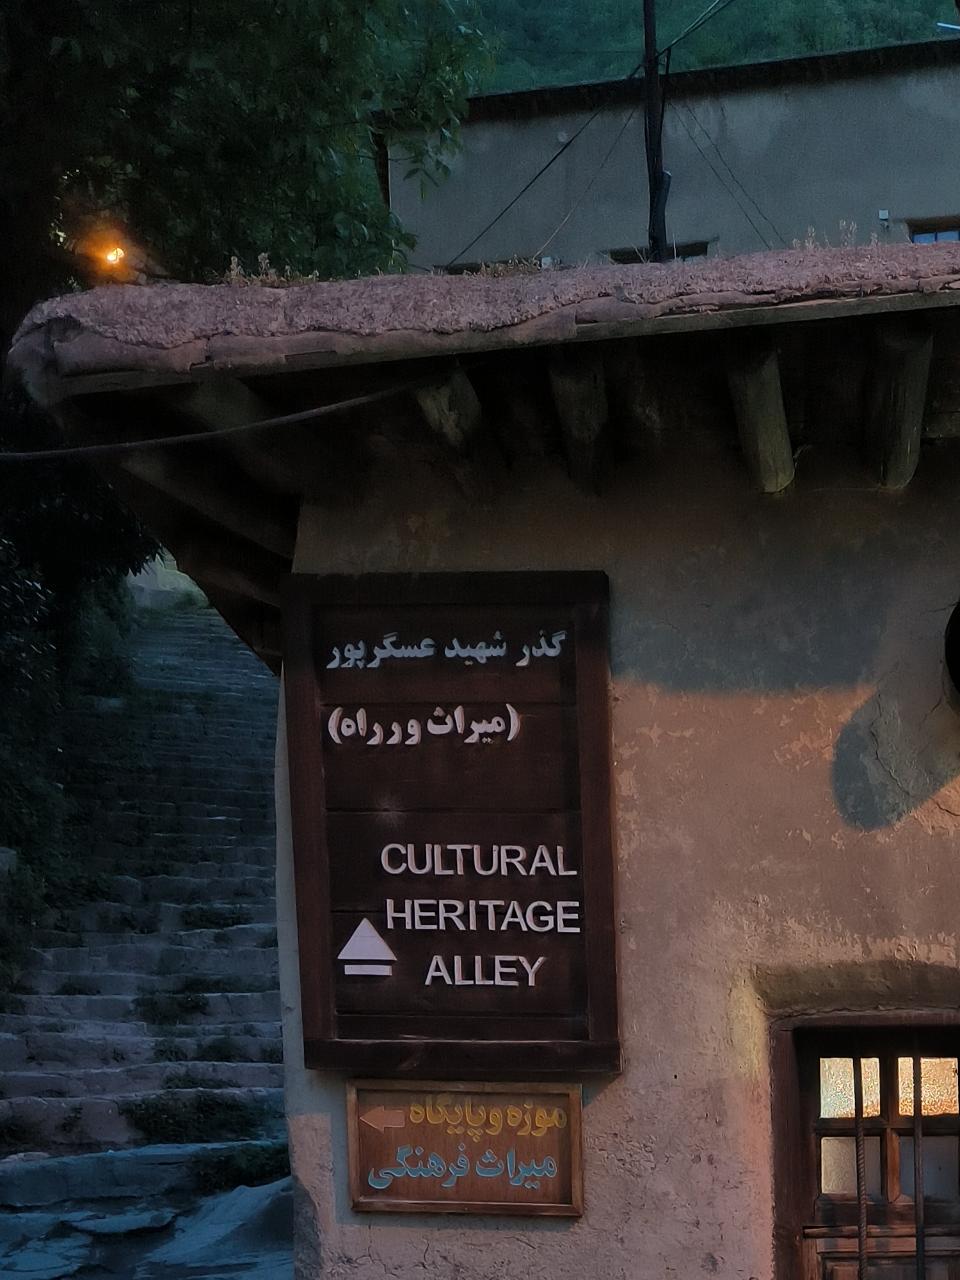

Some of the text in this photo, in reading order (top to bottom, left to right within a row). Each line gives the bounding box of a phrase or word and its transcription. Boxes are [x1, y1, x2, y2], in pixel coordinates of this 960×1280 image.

[444, 630, 507, 664] شهید
[515, 630, 566, 667] گذر
[380, 843, 578, 876] CULTURAL
[386, 899, 581, 933] HERITAGE
[424, 955, 546, 986] ALLEY
[409, 1094, 484, 1142] پایگاه
[506, 1102, 568, 1137] موزه
[367, 1143, 558, 1190] میراث فرهنگی
